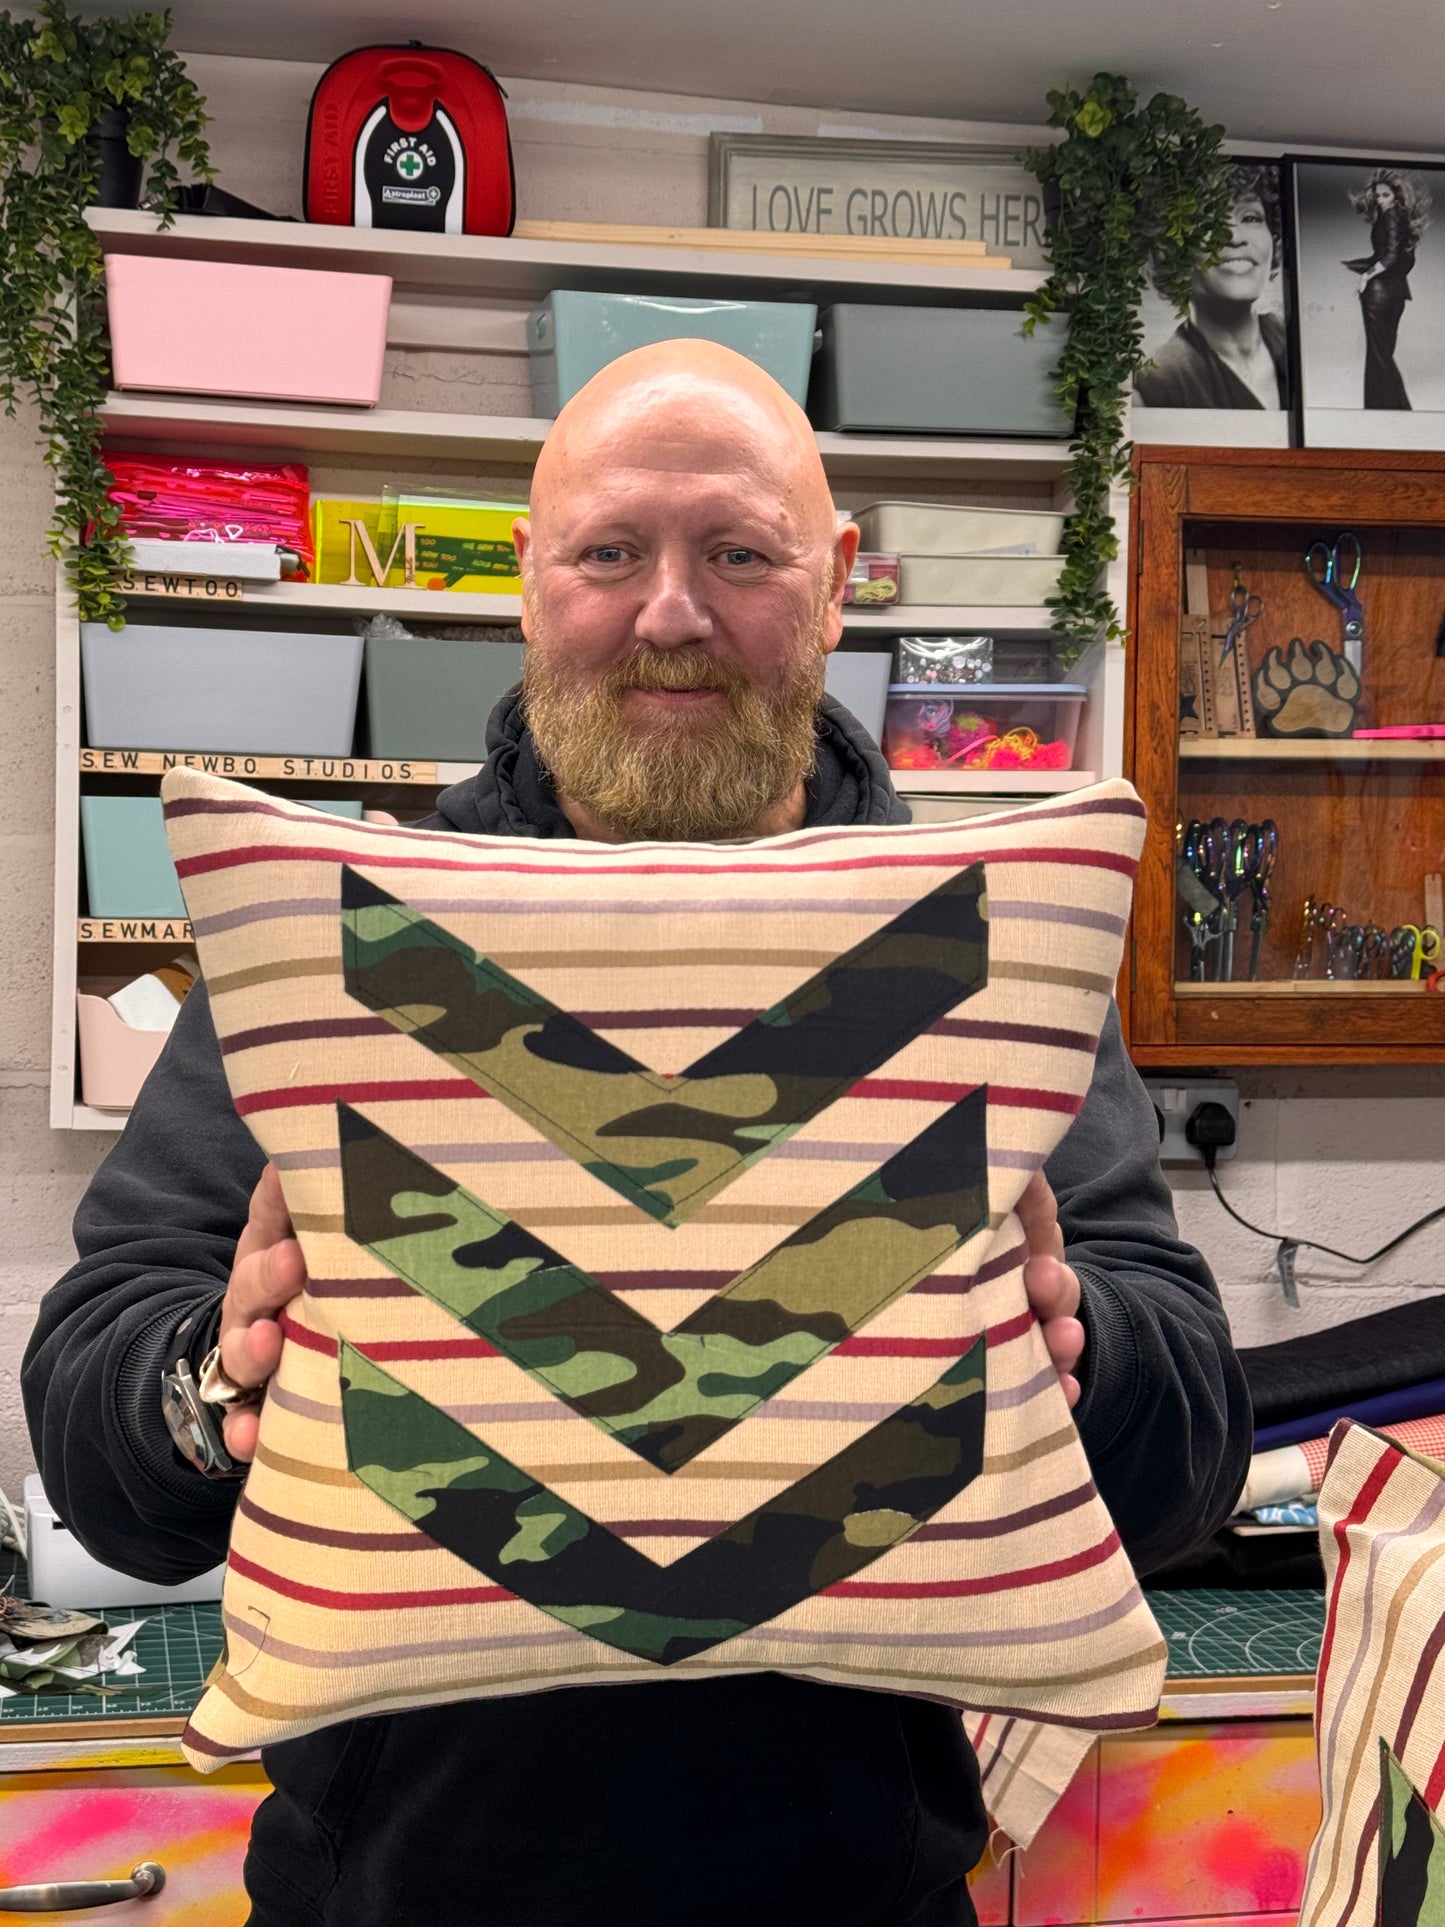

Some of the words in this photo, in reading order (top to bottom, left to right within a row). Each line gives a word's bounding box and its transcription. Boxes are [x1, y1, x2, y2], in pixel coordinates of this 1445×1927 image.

[384, 136, 417, 164] FIRST
[418, 143, 437, 167] AID
[752, 184, 834, 233] LOVE
[846, 187, 966, 239] GROWS
[980, 193, 1043, 248] HER
[82, 751, 139, 770] SEW
[162, 754, 258, 775] NEWBO
[283, 759, 413, 780] STUDIOS
[80, 922, 193, 939] SEWMAR
